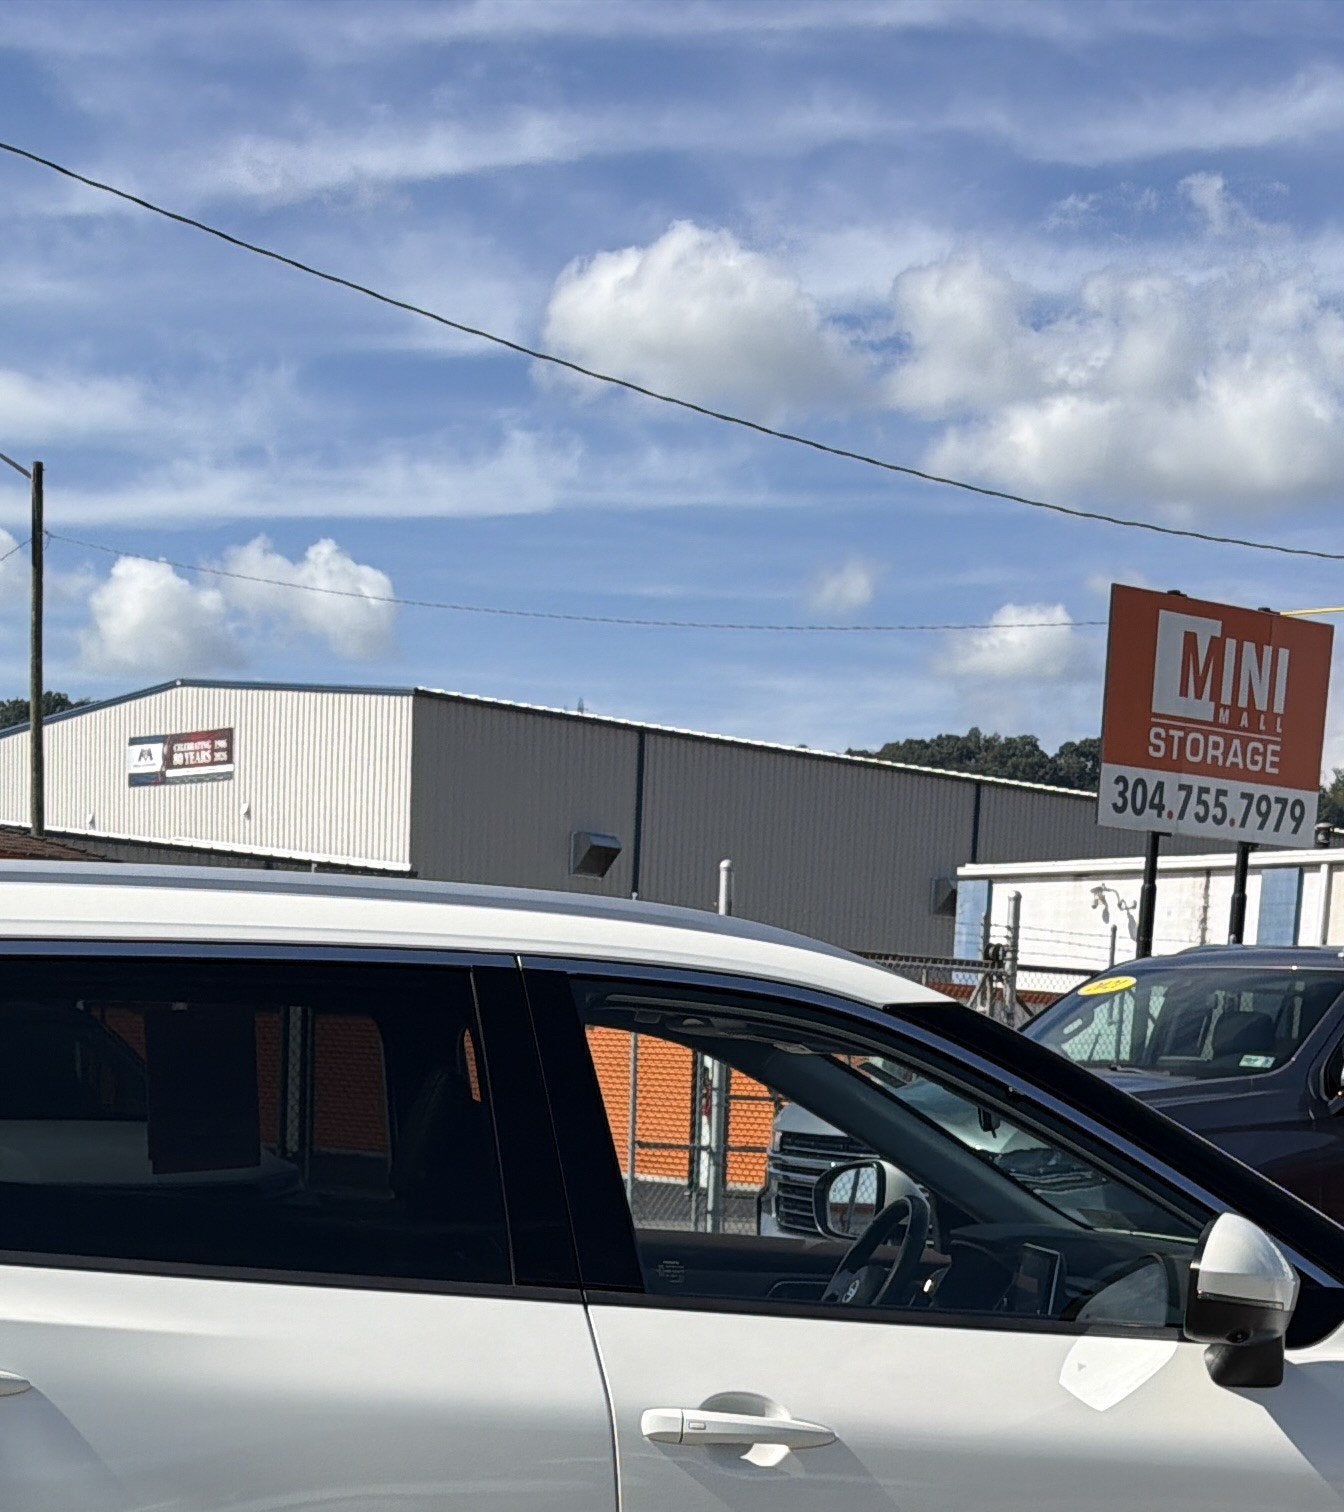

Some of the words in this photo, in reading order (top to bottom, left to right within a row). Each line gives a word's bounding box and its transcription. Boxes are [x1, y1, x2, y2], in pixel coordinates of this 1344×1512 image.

[1151, 609, 1290, 722] MINI
[1218, 704, 1283, 733] MALL
[184, 750, 212, 765] YEARS
[1148, 726, 1282, 775] STORAGE
[1111, 774, 1306, 836] 304.755.7979
